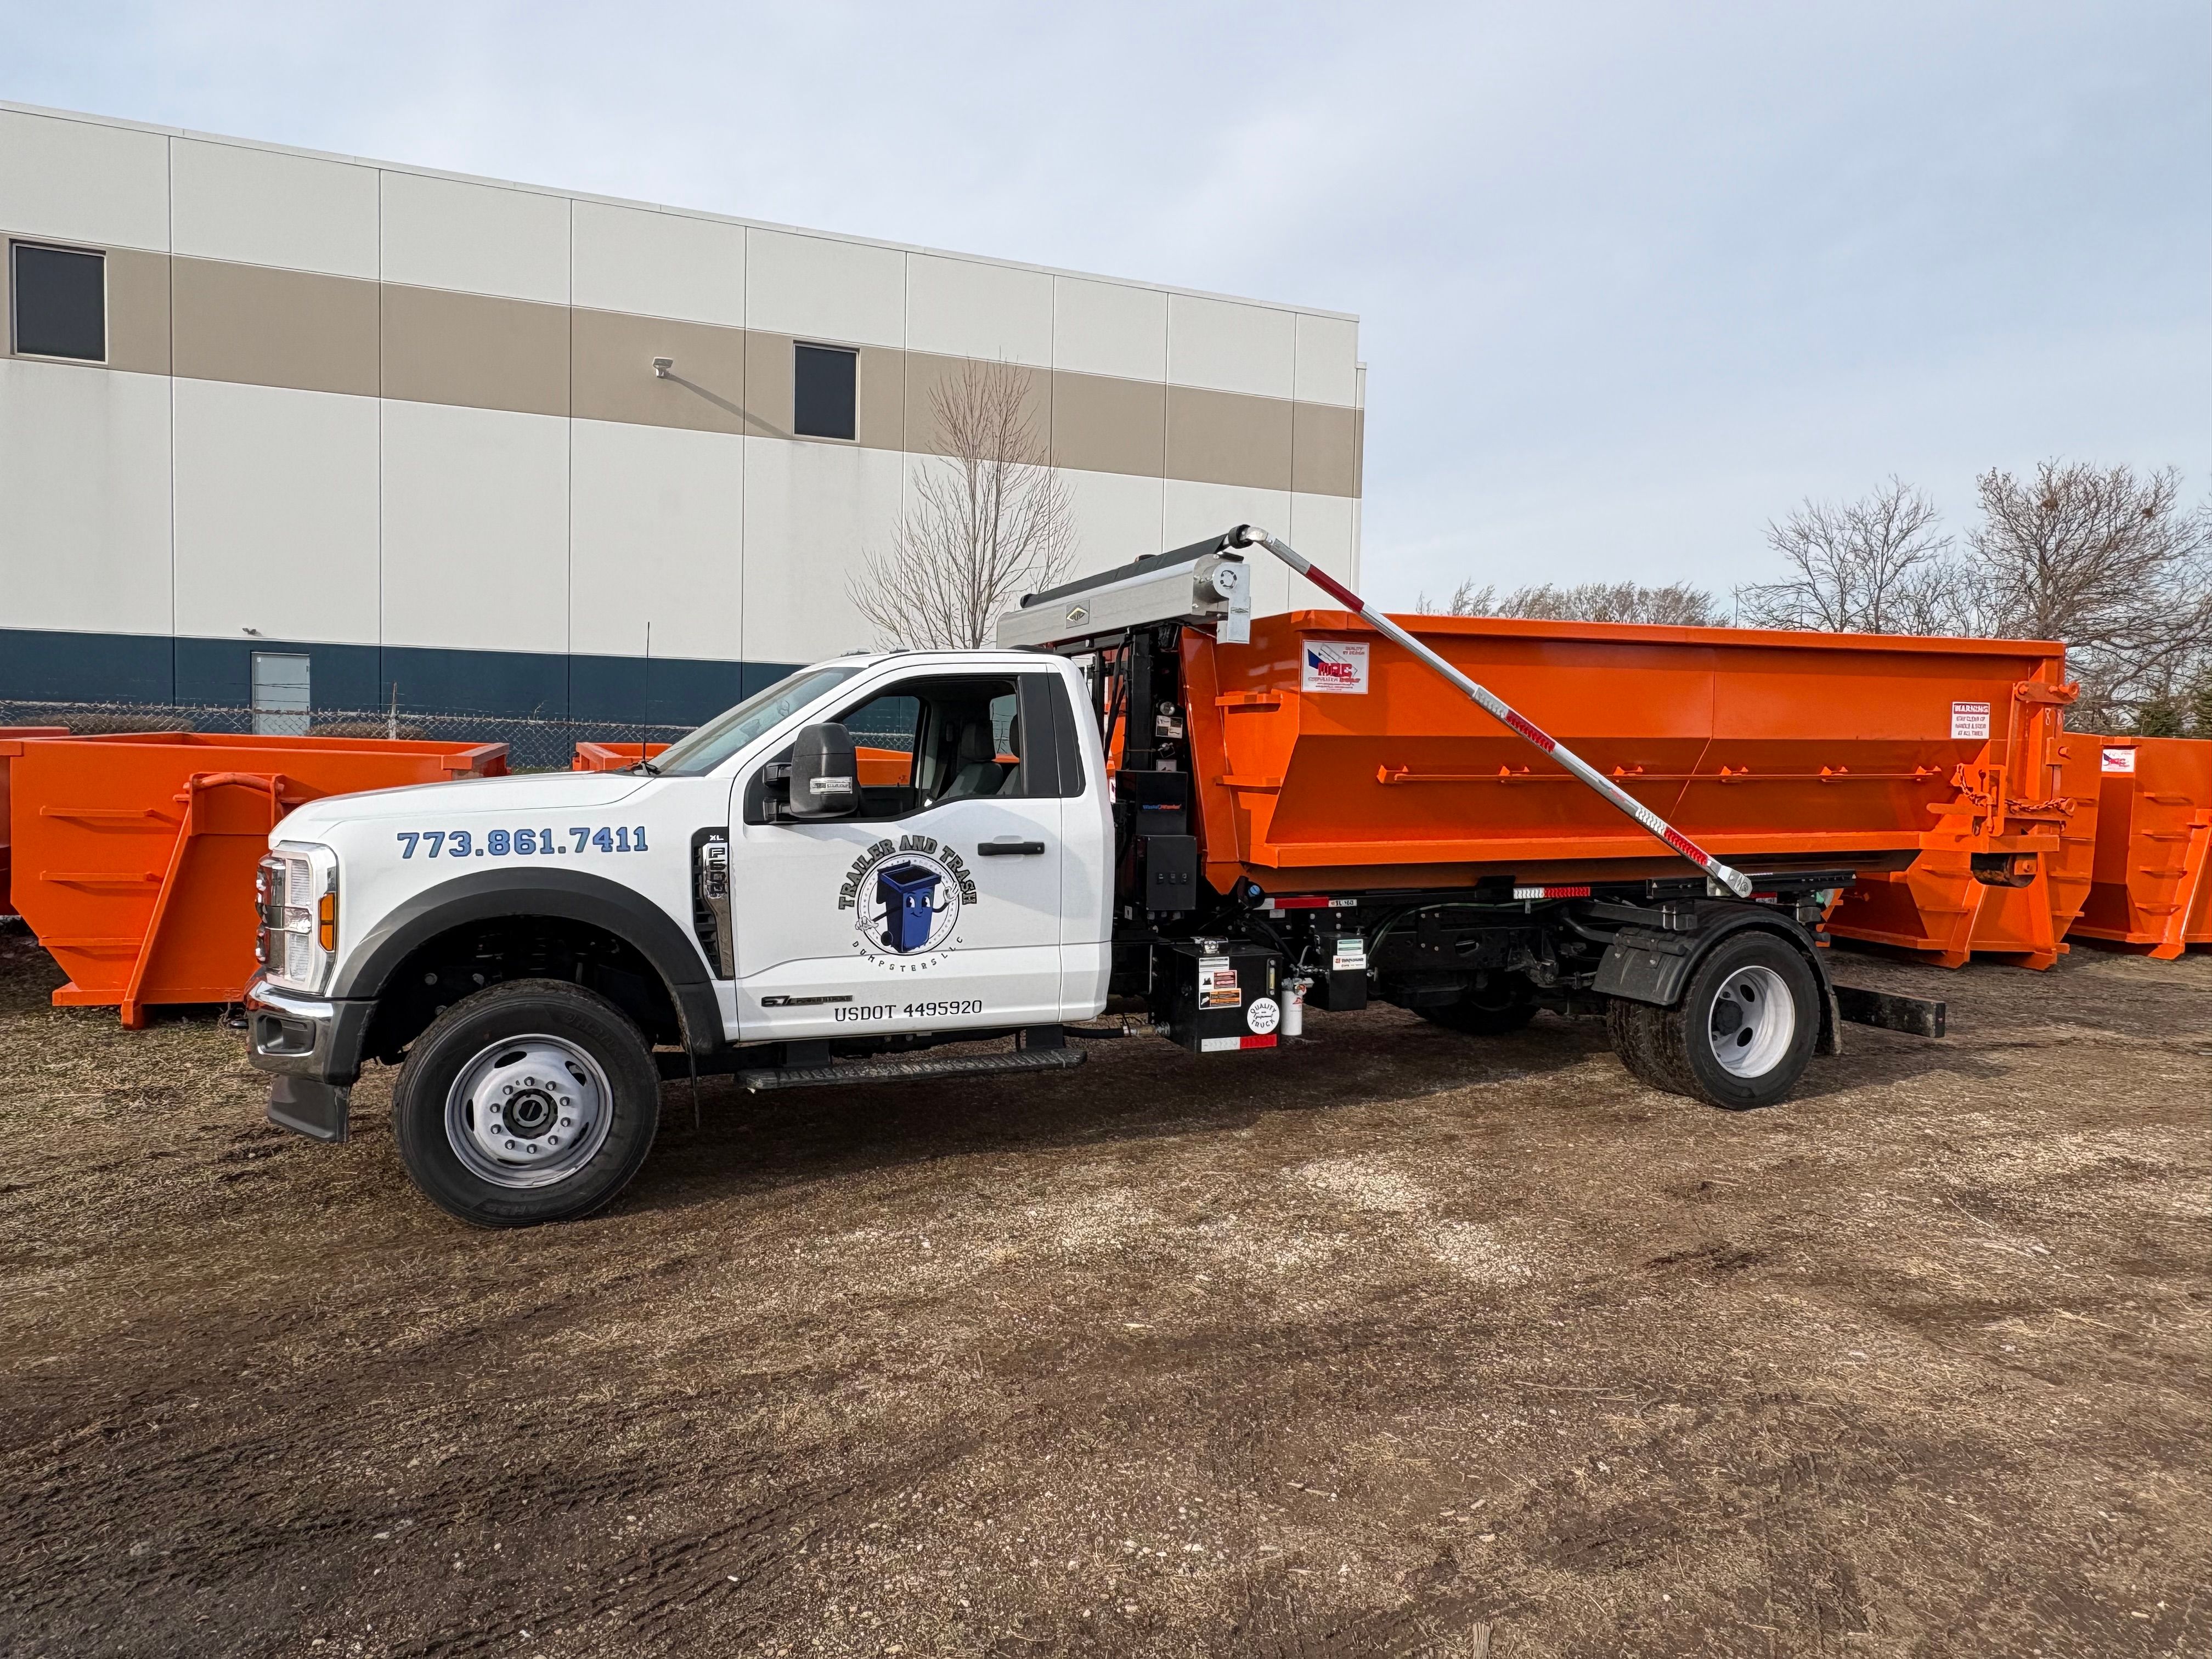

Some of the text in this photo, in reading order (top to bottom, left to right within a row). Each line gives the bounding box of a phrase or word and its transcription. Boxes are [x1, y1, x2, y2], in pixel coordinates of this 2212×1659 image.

[1955, 704, 1989, 713] WARNING
[397, 826, 648, 859] 773.861.7411
[838, 835, 977, 910] TRAILER AND TRASH
[852, 936, 963, 972] DUMPSTERS LLC
[834, 1000, 983, 1022] USDOT 4495920
[1250, 1003, 1277, 1014] QUALITY
[1251, 1019, 1276, 1028] TRUCK
